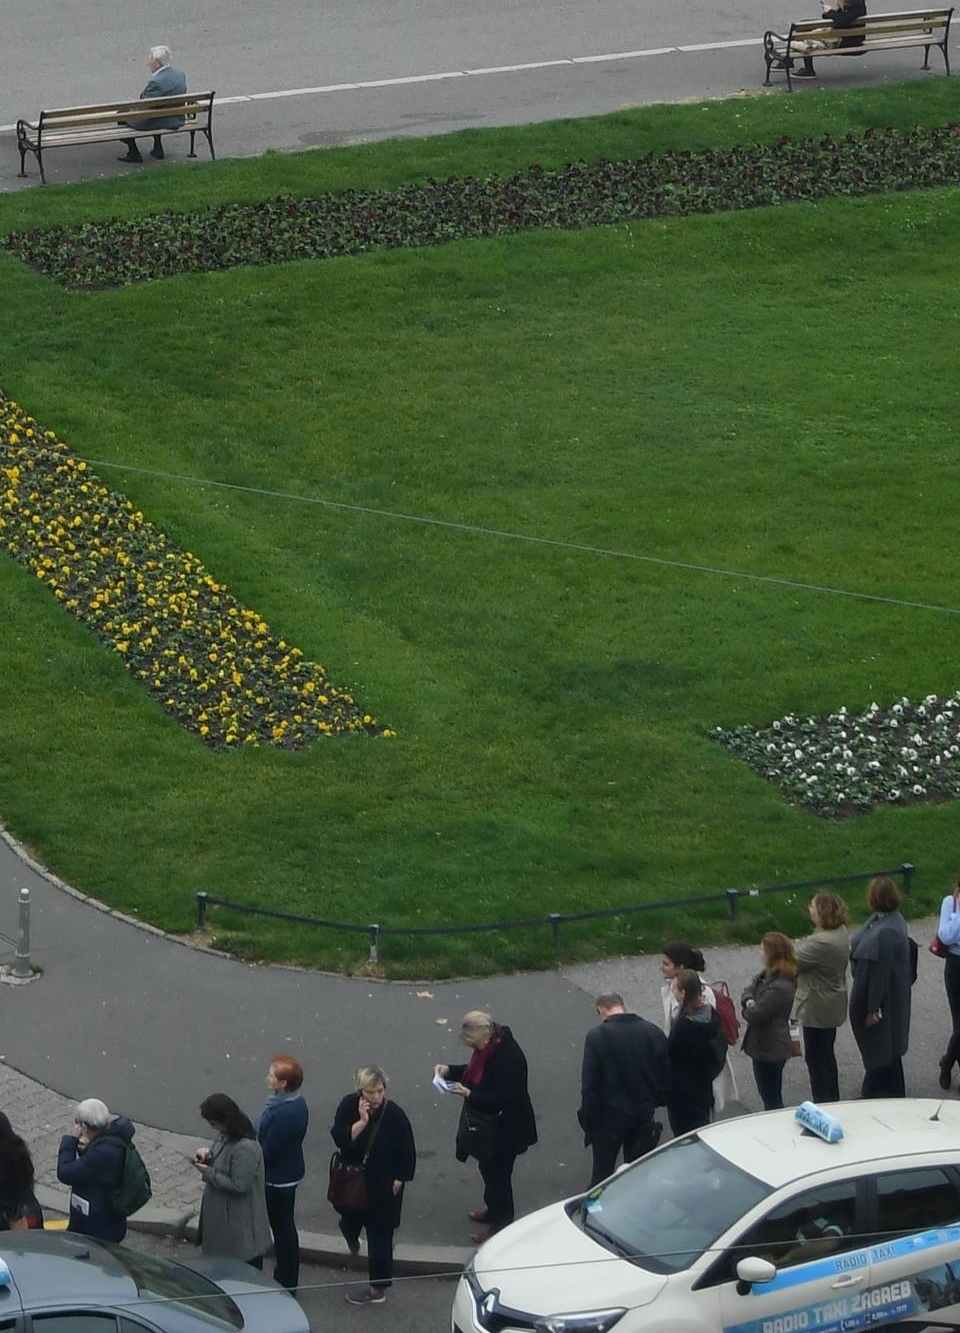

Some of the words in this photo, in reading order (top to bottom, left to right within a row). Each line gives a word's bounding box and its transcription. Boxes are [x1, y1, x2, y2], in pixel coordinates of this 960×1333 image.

[835, 1253, 867, 1270] RADIO
[872, 1244, 897, 1263] TAXI
[762, 1314, 809, 1333] RADIO
[813, 1297, 848, 1324] TAXI
[852, 1280, 912, 1313] ZAGREB
